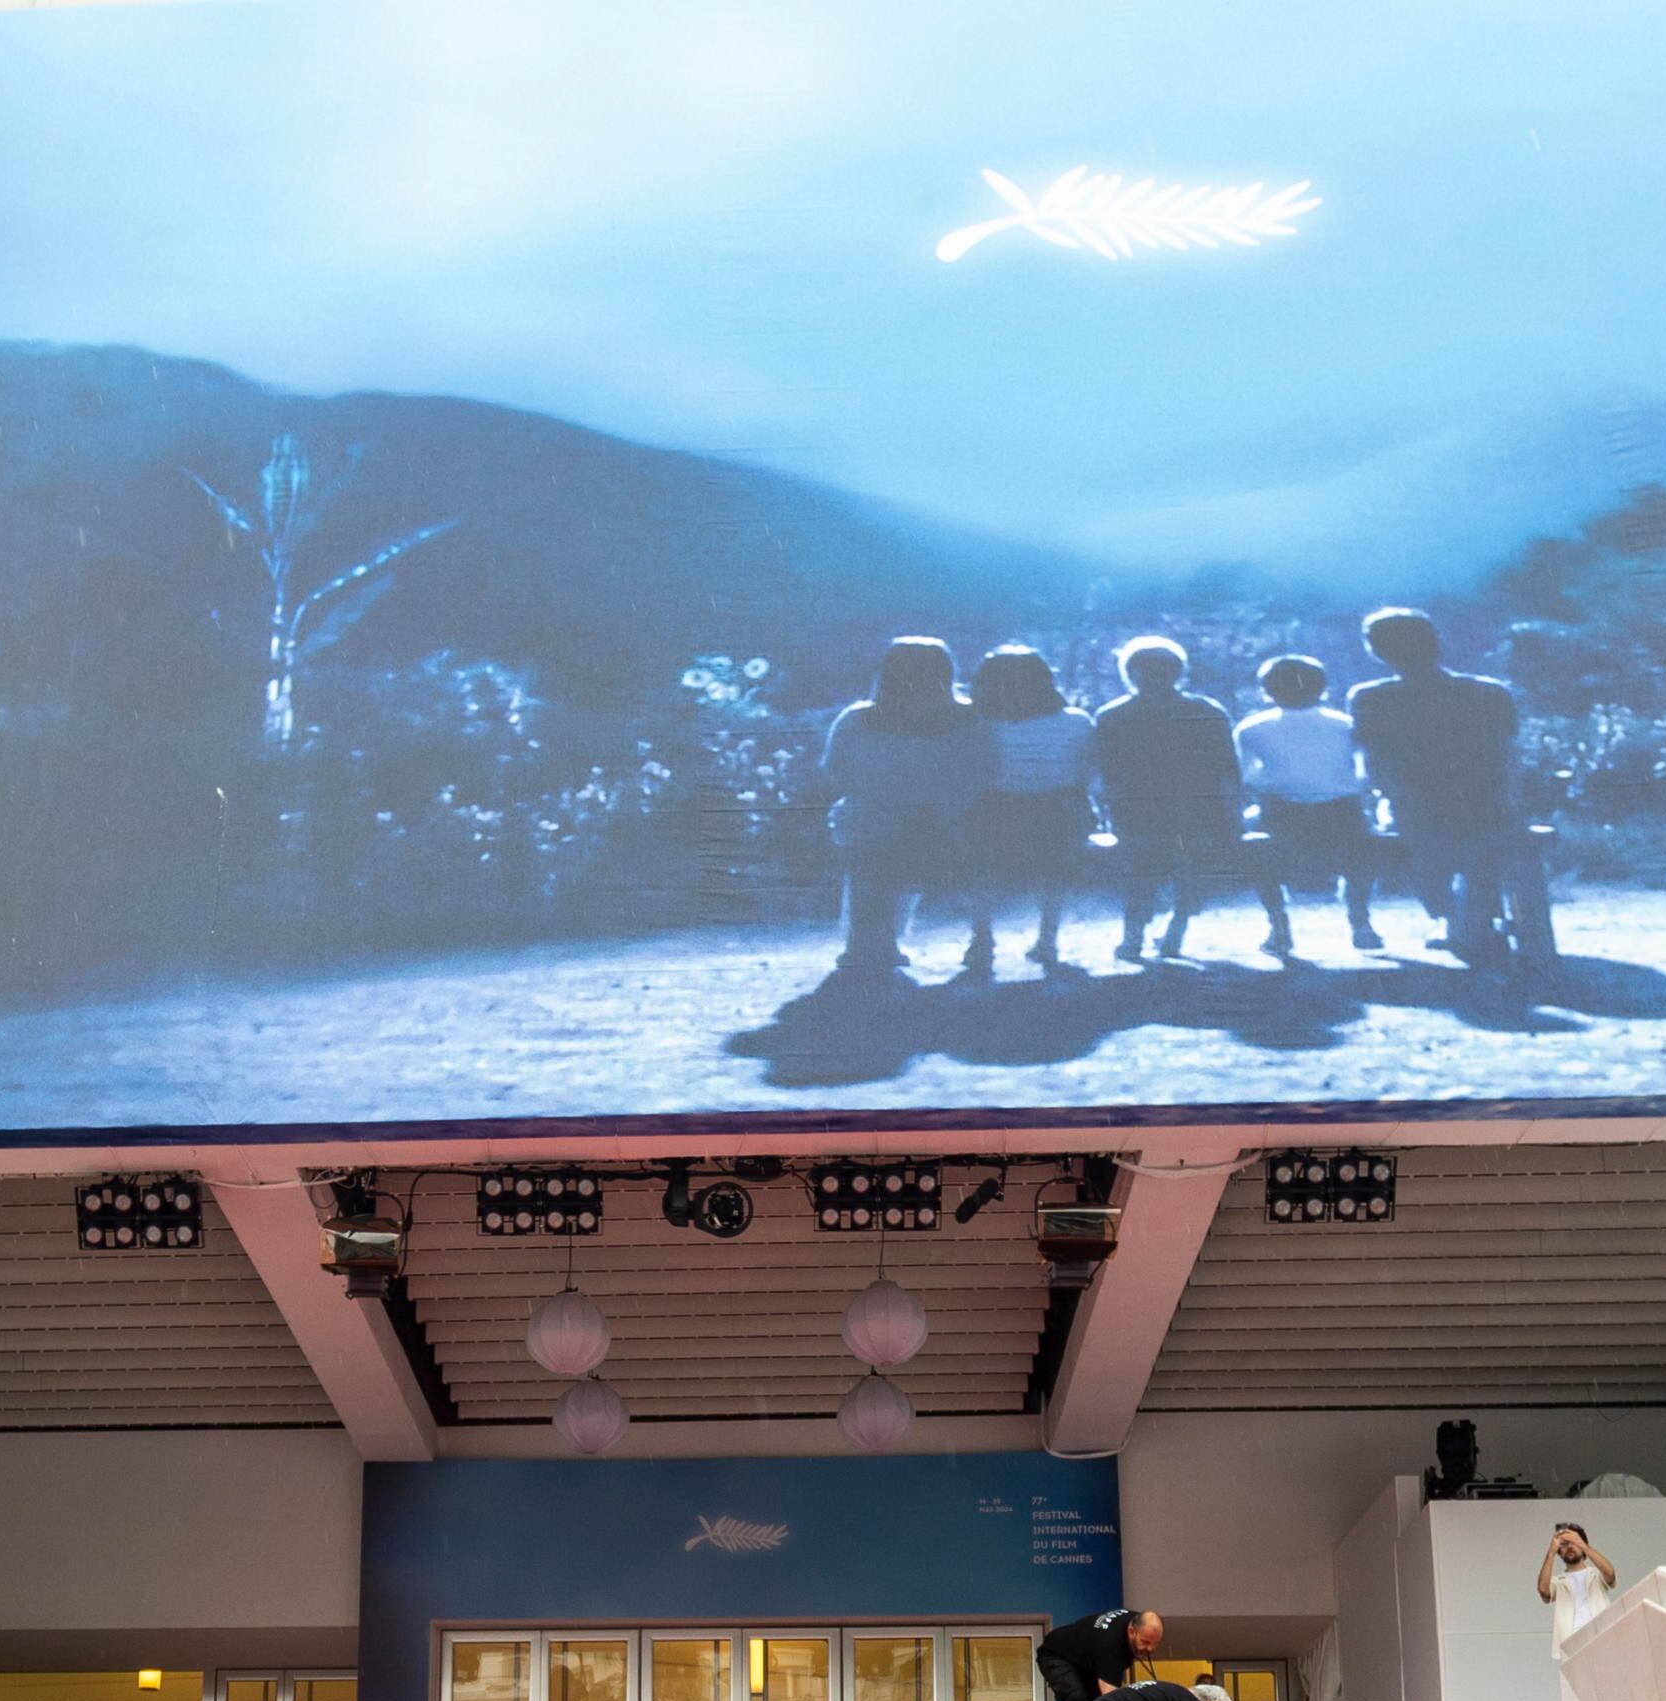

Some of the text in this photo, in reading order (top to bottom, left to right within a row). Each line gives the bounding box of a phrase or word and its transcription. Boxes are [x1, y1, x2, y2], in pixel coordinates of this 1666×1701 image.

[1032, 1511, 1081, 1520] FESTIVAL
[1033, 1525, 1116, 1535] INTERNATIONAL
[1033, 1540, 1077, 1550] DU FILM
[1033, 1554, 1093, 1565] DE CANNES
